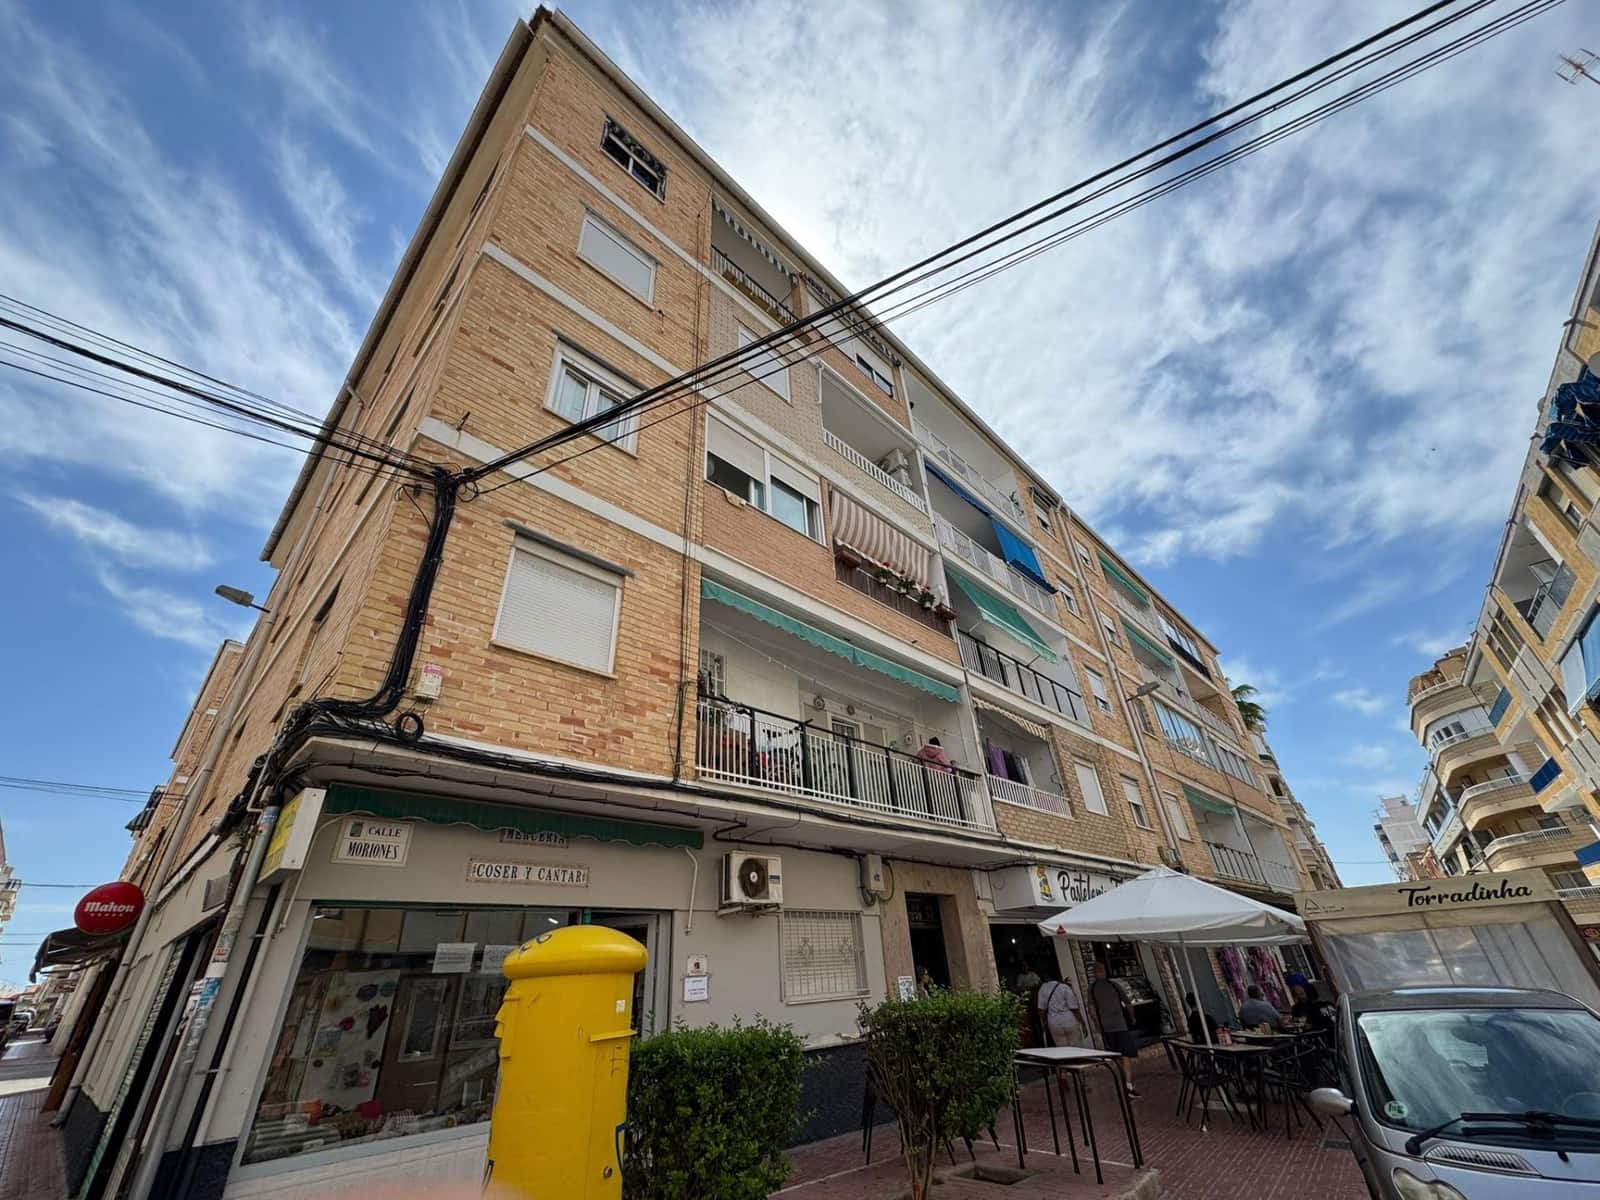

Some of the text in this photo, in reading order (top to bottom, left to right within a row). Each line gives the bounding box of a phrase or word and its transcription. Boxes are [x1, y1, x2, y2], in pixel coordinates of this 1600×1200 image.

[368, 825, 401, 838] CALLE
[347, 841, 400, 860] MORIONES
[525, 866, 532, 881] Y
[1057, 870, 1108, 904] Pasteleri
[1398, 879, 1533, 907] Torradinha
[84, 901, 135, 913] Mahou
